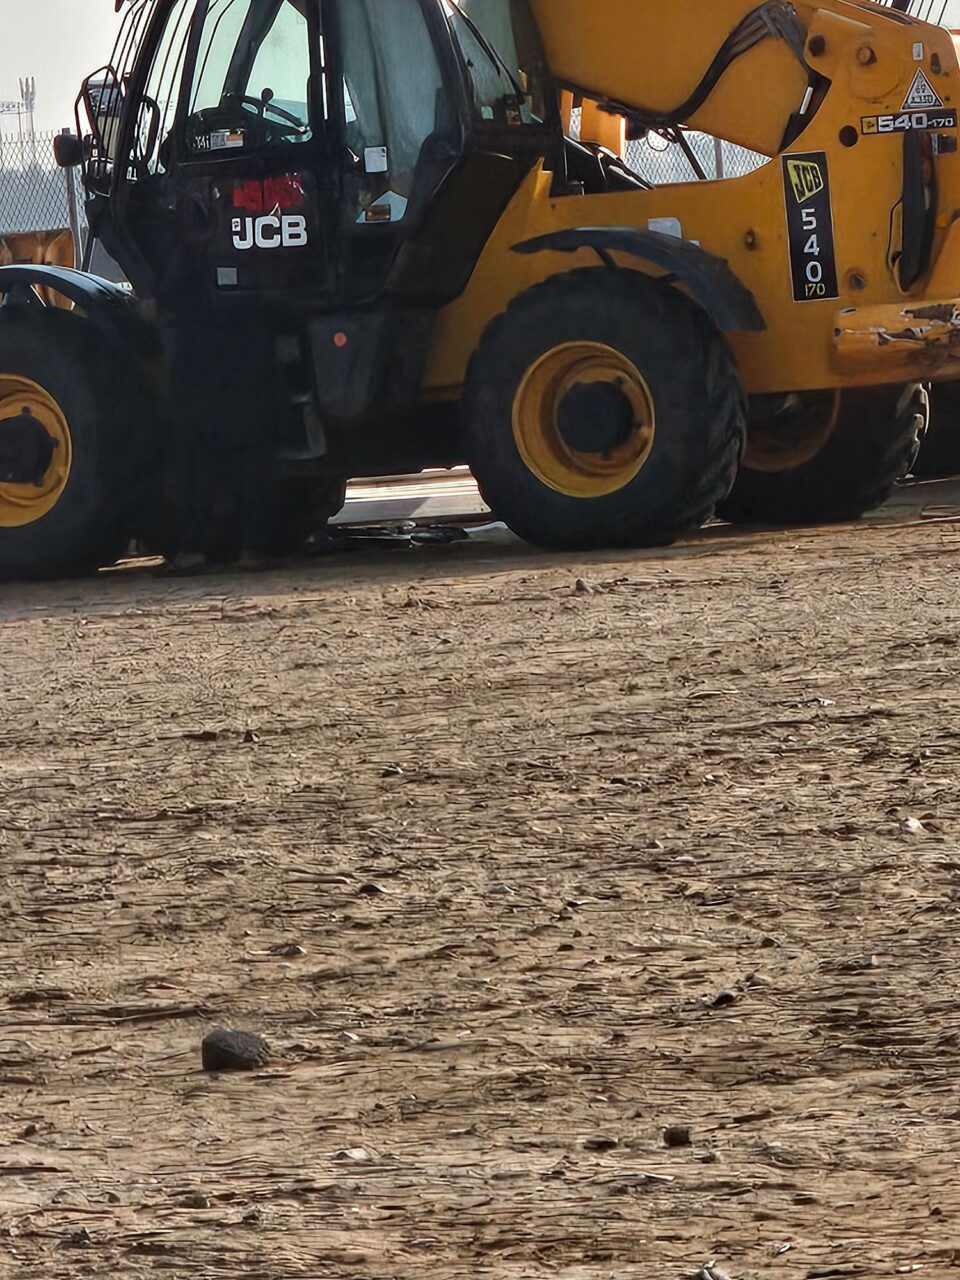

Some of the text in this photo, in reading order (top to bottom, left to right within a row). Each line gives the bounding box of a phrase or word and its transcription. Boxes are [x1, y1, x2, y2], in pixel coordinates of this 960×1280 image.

[789, 161, 822, 200] JCB
[232, 215, 308, 250] JCB
[801, 208, 822, 283] 540
[804, 283, 826, 297] 170
